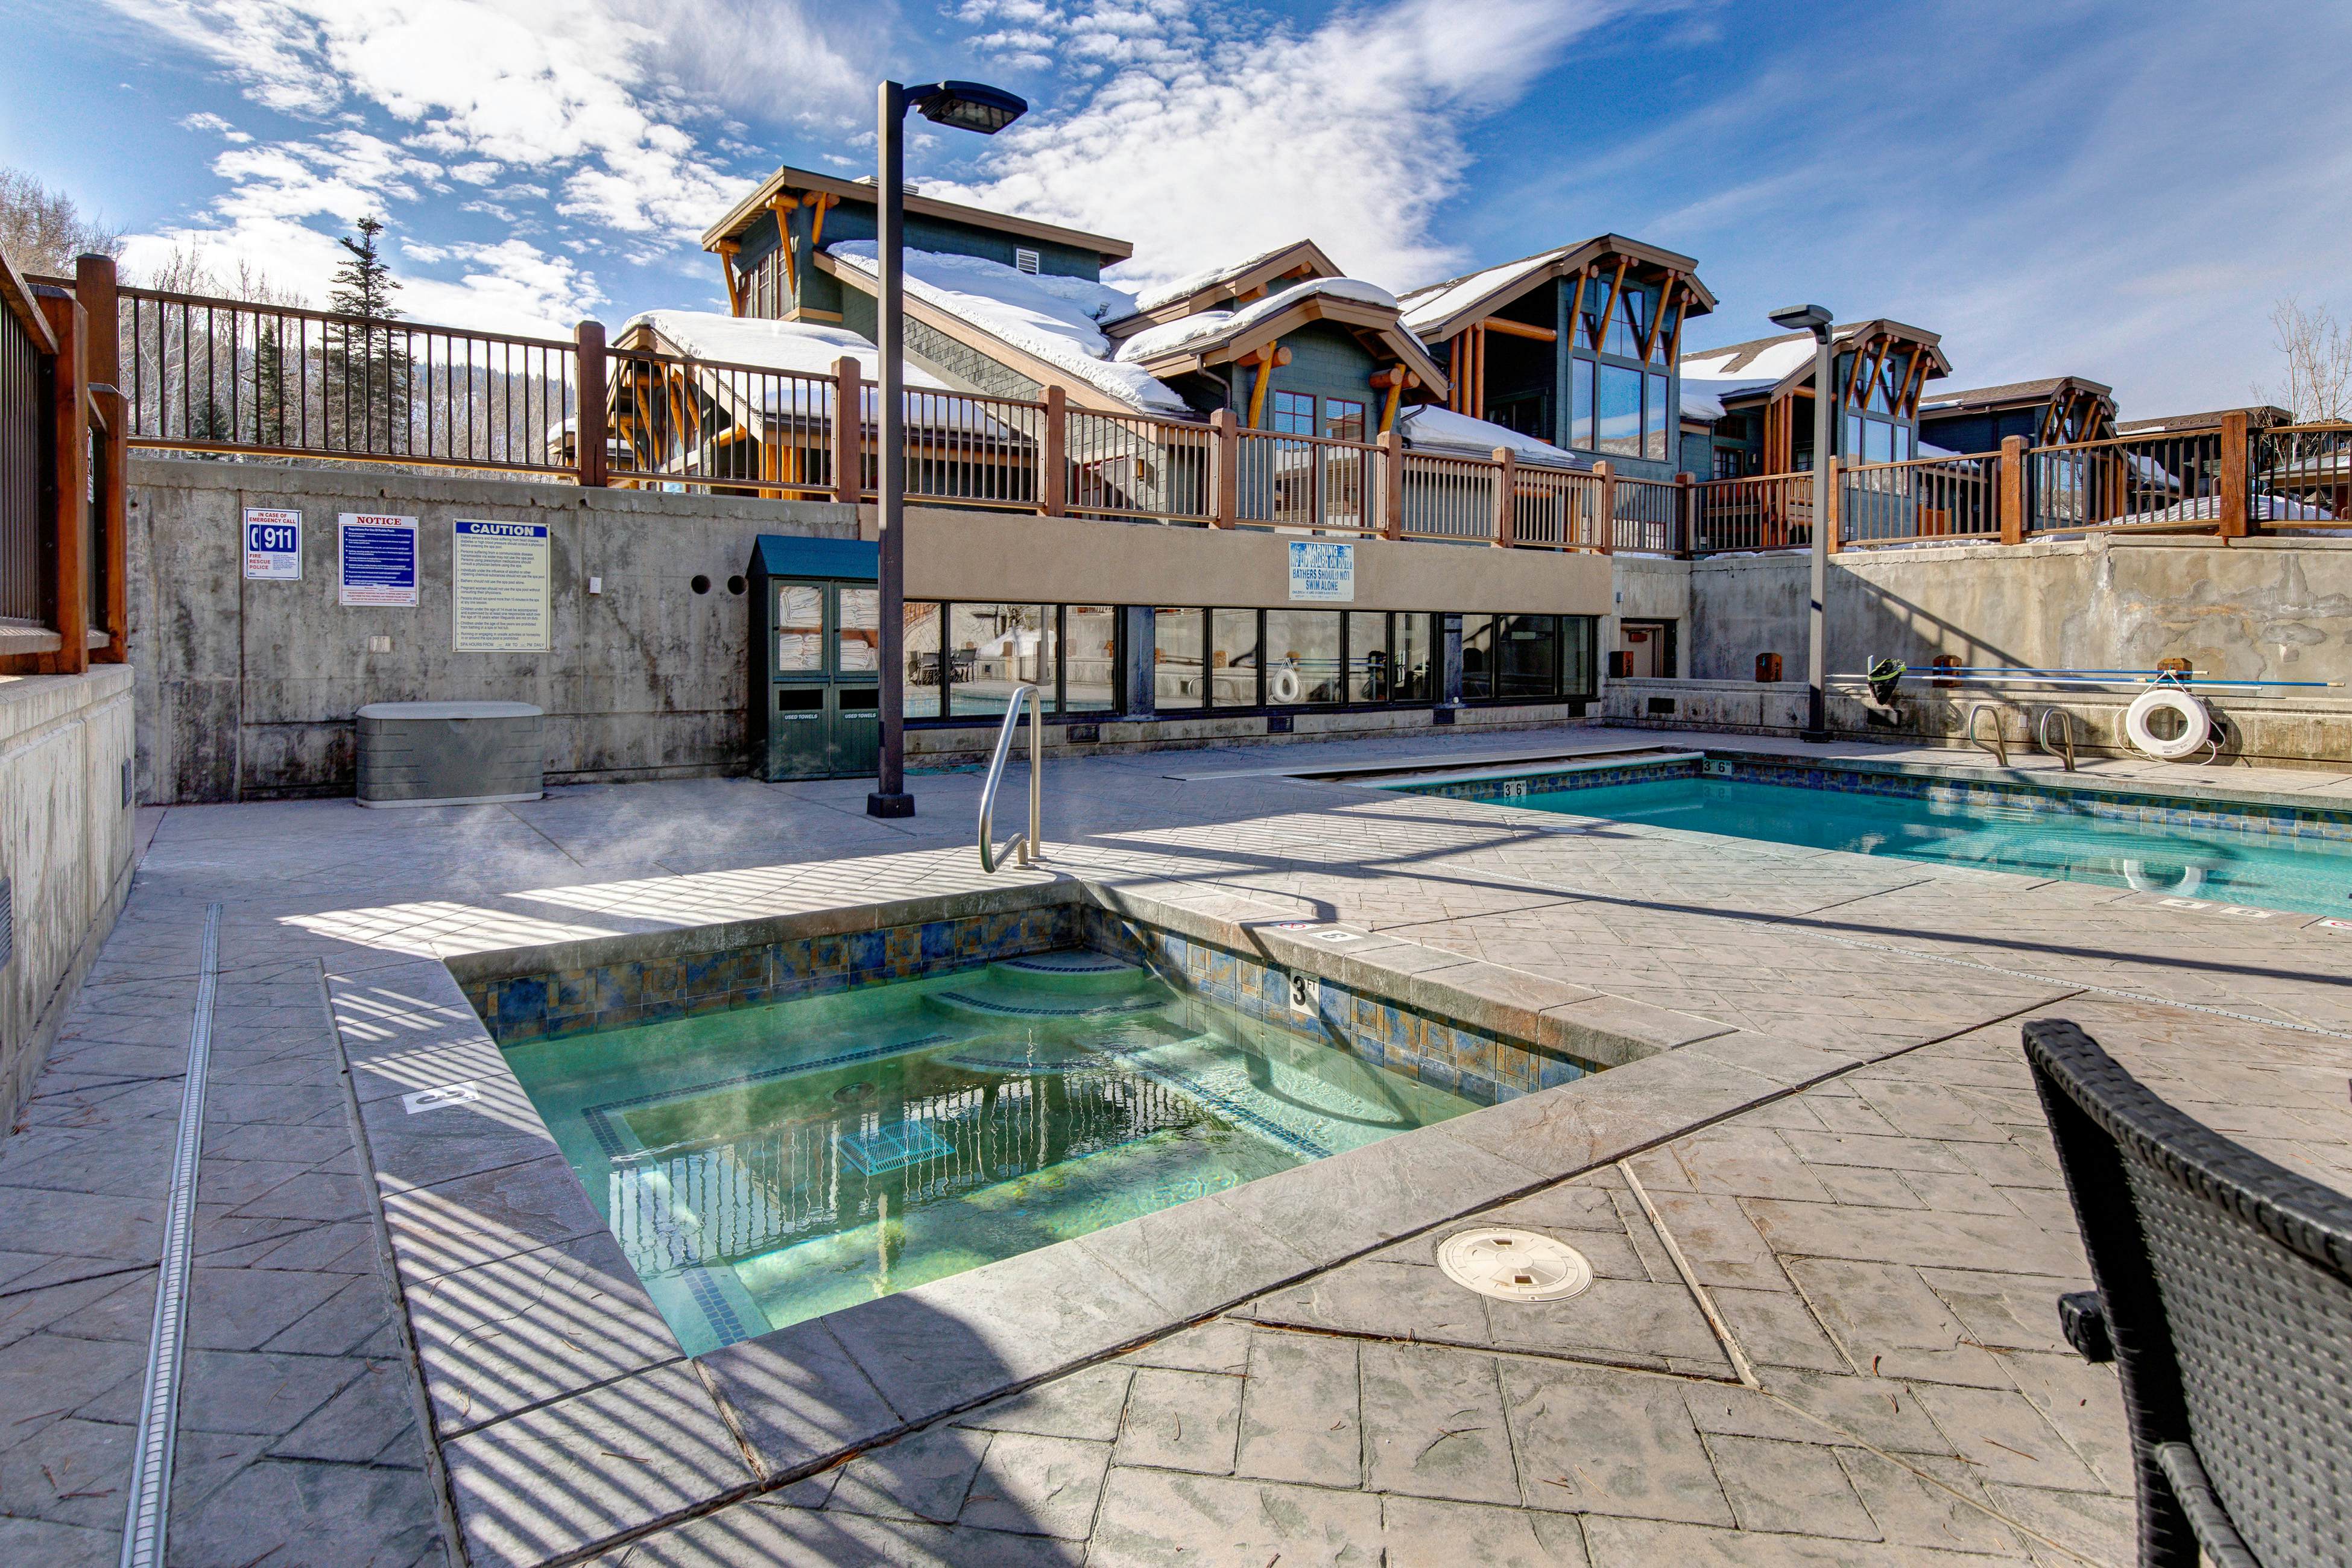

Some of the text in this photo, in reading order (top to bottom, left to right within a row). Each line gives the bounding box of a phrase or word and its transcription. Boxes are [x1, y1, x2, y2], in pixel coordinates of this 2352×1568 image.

[356, 516, 402, 525] NOTICE
[470, 523, 534, 536] CAUTION
[264, 528, 292, 549] 911
[1306, 544, 1338, 557] WARNING
[1293, 569, 1350, 580] BATHERS SHOULD NOT
[1306, 580, 1338, 591] SWIM ALONE
[1704, 760, 1710, 771] 3
[1719, 762, 1725, 773] 6
[1505, 784, 1510, 796] 3
[1516, 783, 1522, 795] 6
[1293, 975, 1317, 1006] 3 FT
[416, 1090, 466, 1105] 3
